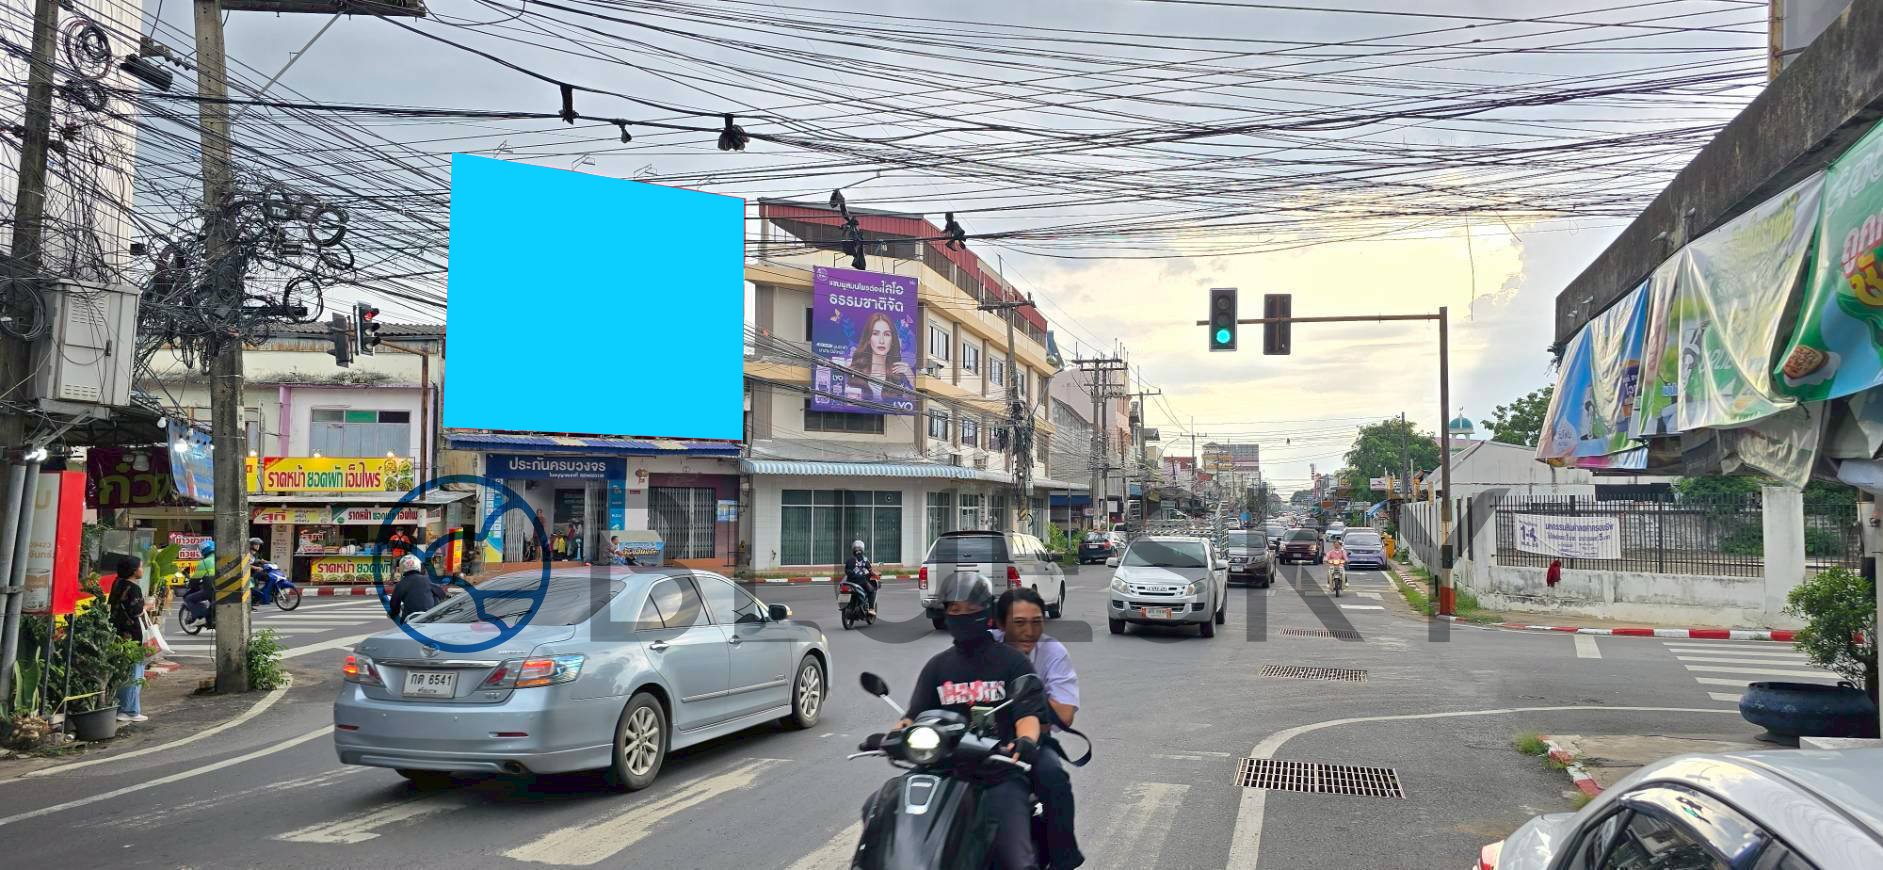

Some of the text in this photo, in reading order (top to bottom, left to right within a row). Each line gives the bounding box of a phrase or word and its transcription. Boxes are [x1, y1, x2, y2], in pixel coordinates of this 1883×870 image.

[829, 293, 904, 313] ธรรมชาติจัด
[509, 456, 607, 472] ประกันครบวงจร
[268, 465, 306, 488] ราดหน้า
[345, 462, 382, 488] เอ็มไพร์
[317, 559, 355, 574] ราดหน้า
[428, 673, 453, 686] 6541
